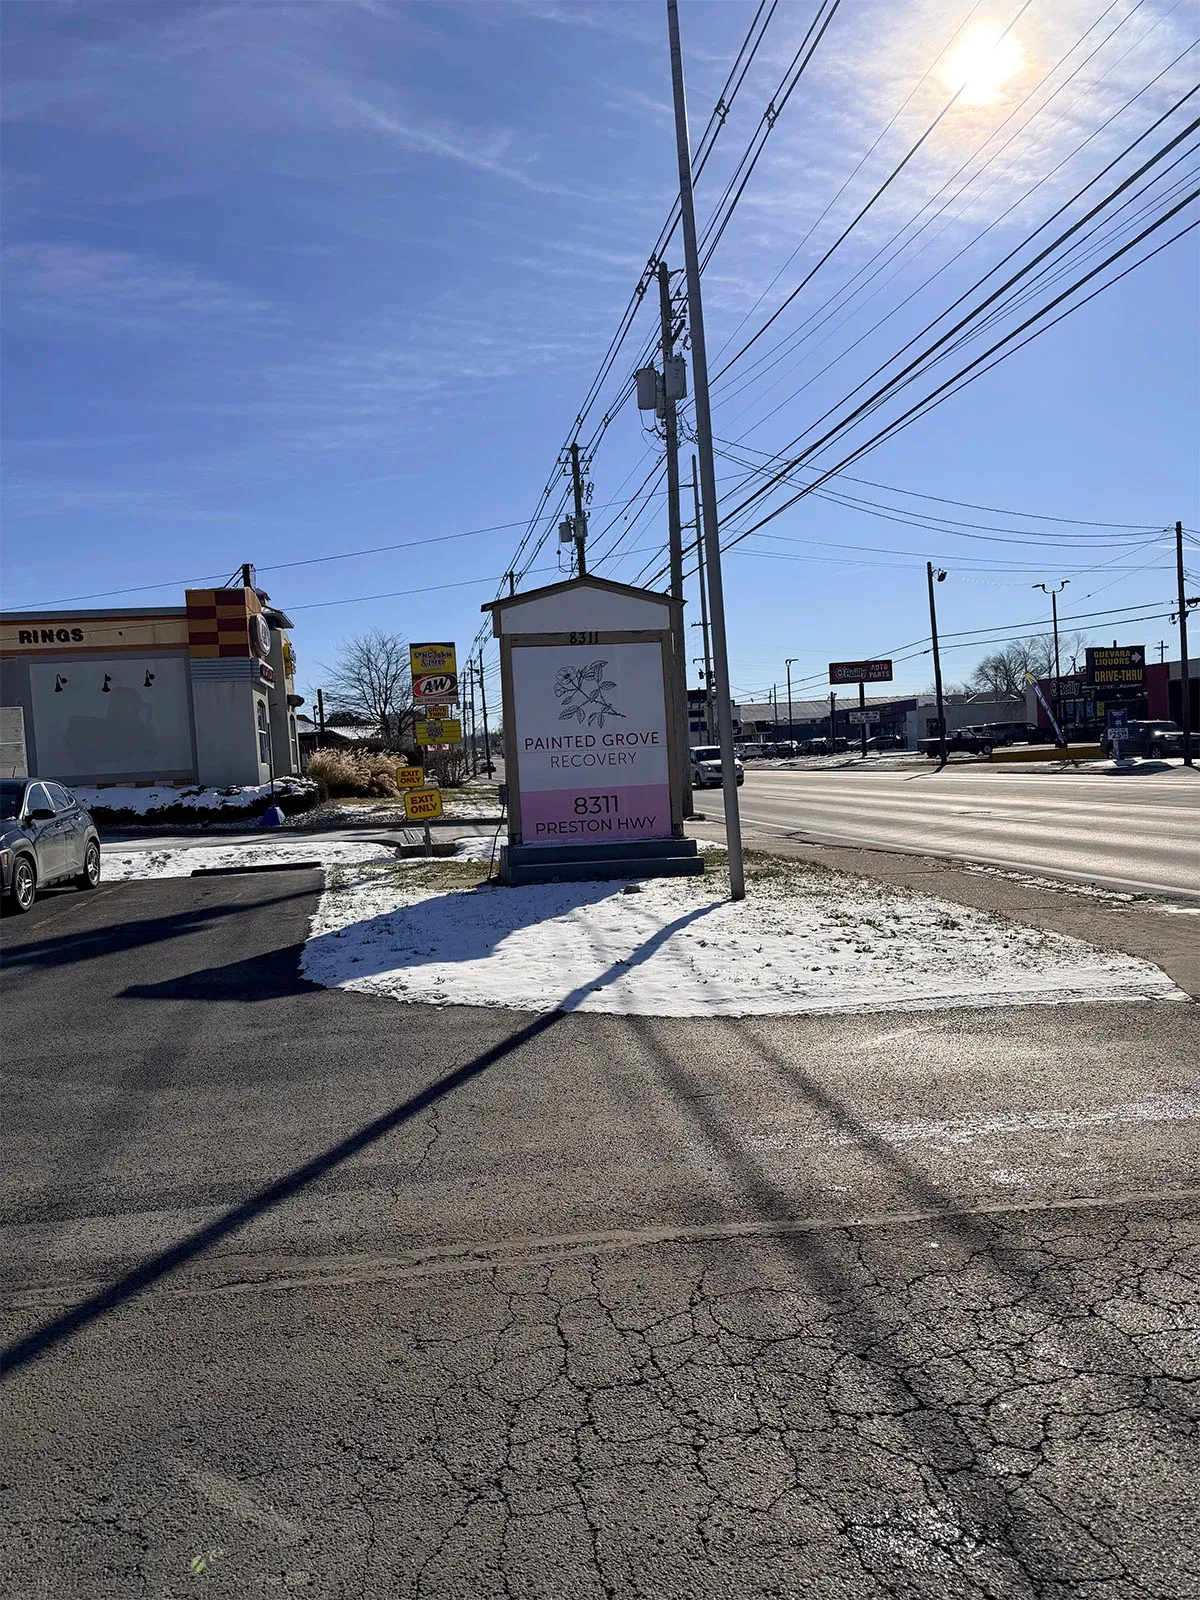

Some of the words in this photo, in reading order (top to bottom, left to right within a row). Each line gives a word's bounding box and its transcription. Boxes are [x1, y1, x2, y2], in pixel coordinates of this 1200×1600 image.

[18, 628, 84, 645] RINGS
[569, 631, 599, 644] 8311
[1093, 650, 1131, 659] GUEVARA
[1095, 658, 1130, 666] LIQUORS
[1094, 669, 1143, 683] DRIVE-THRU
[1050, 680, 1080, 697] OReilly
[525, 735, 596, 751] PAINTED
[602, 732, 659, 746] GROVE
[550, 752, 637, 768] RECOVERY
[410, 794, 434, 805] EXIT
[573, 795, 619, 815] 8311
[410, 803, 437, 814] ONLY
[536, 819, 613, 835] PRESTON
[618, 816, 657, 830] HWY
